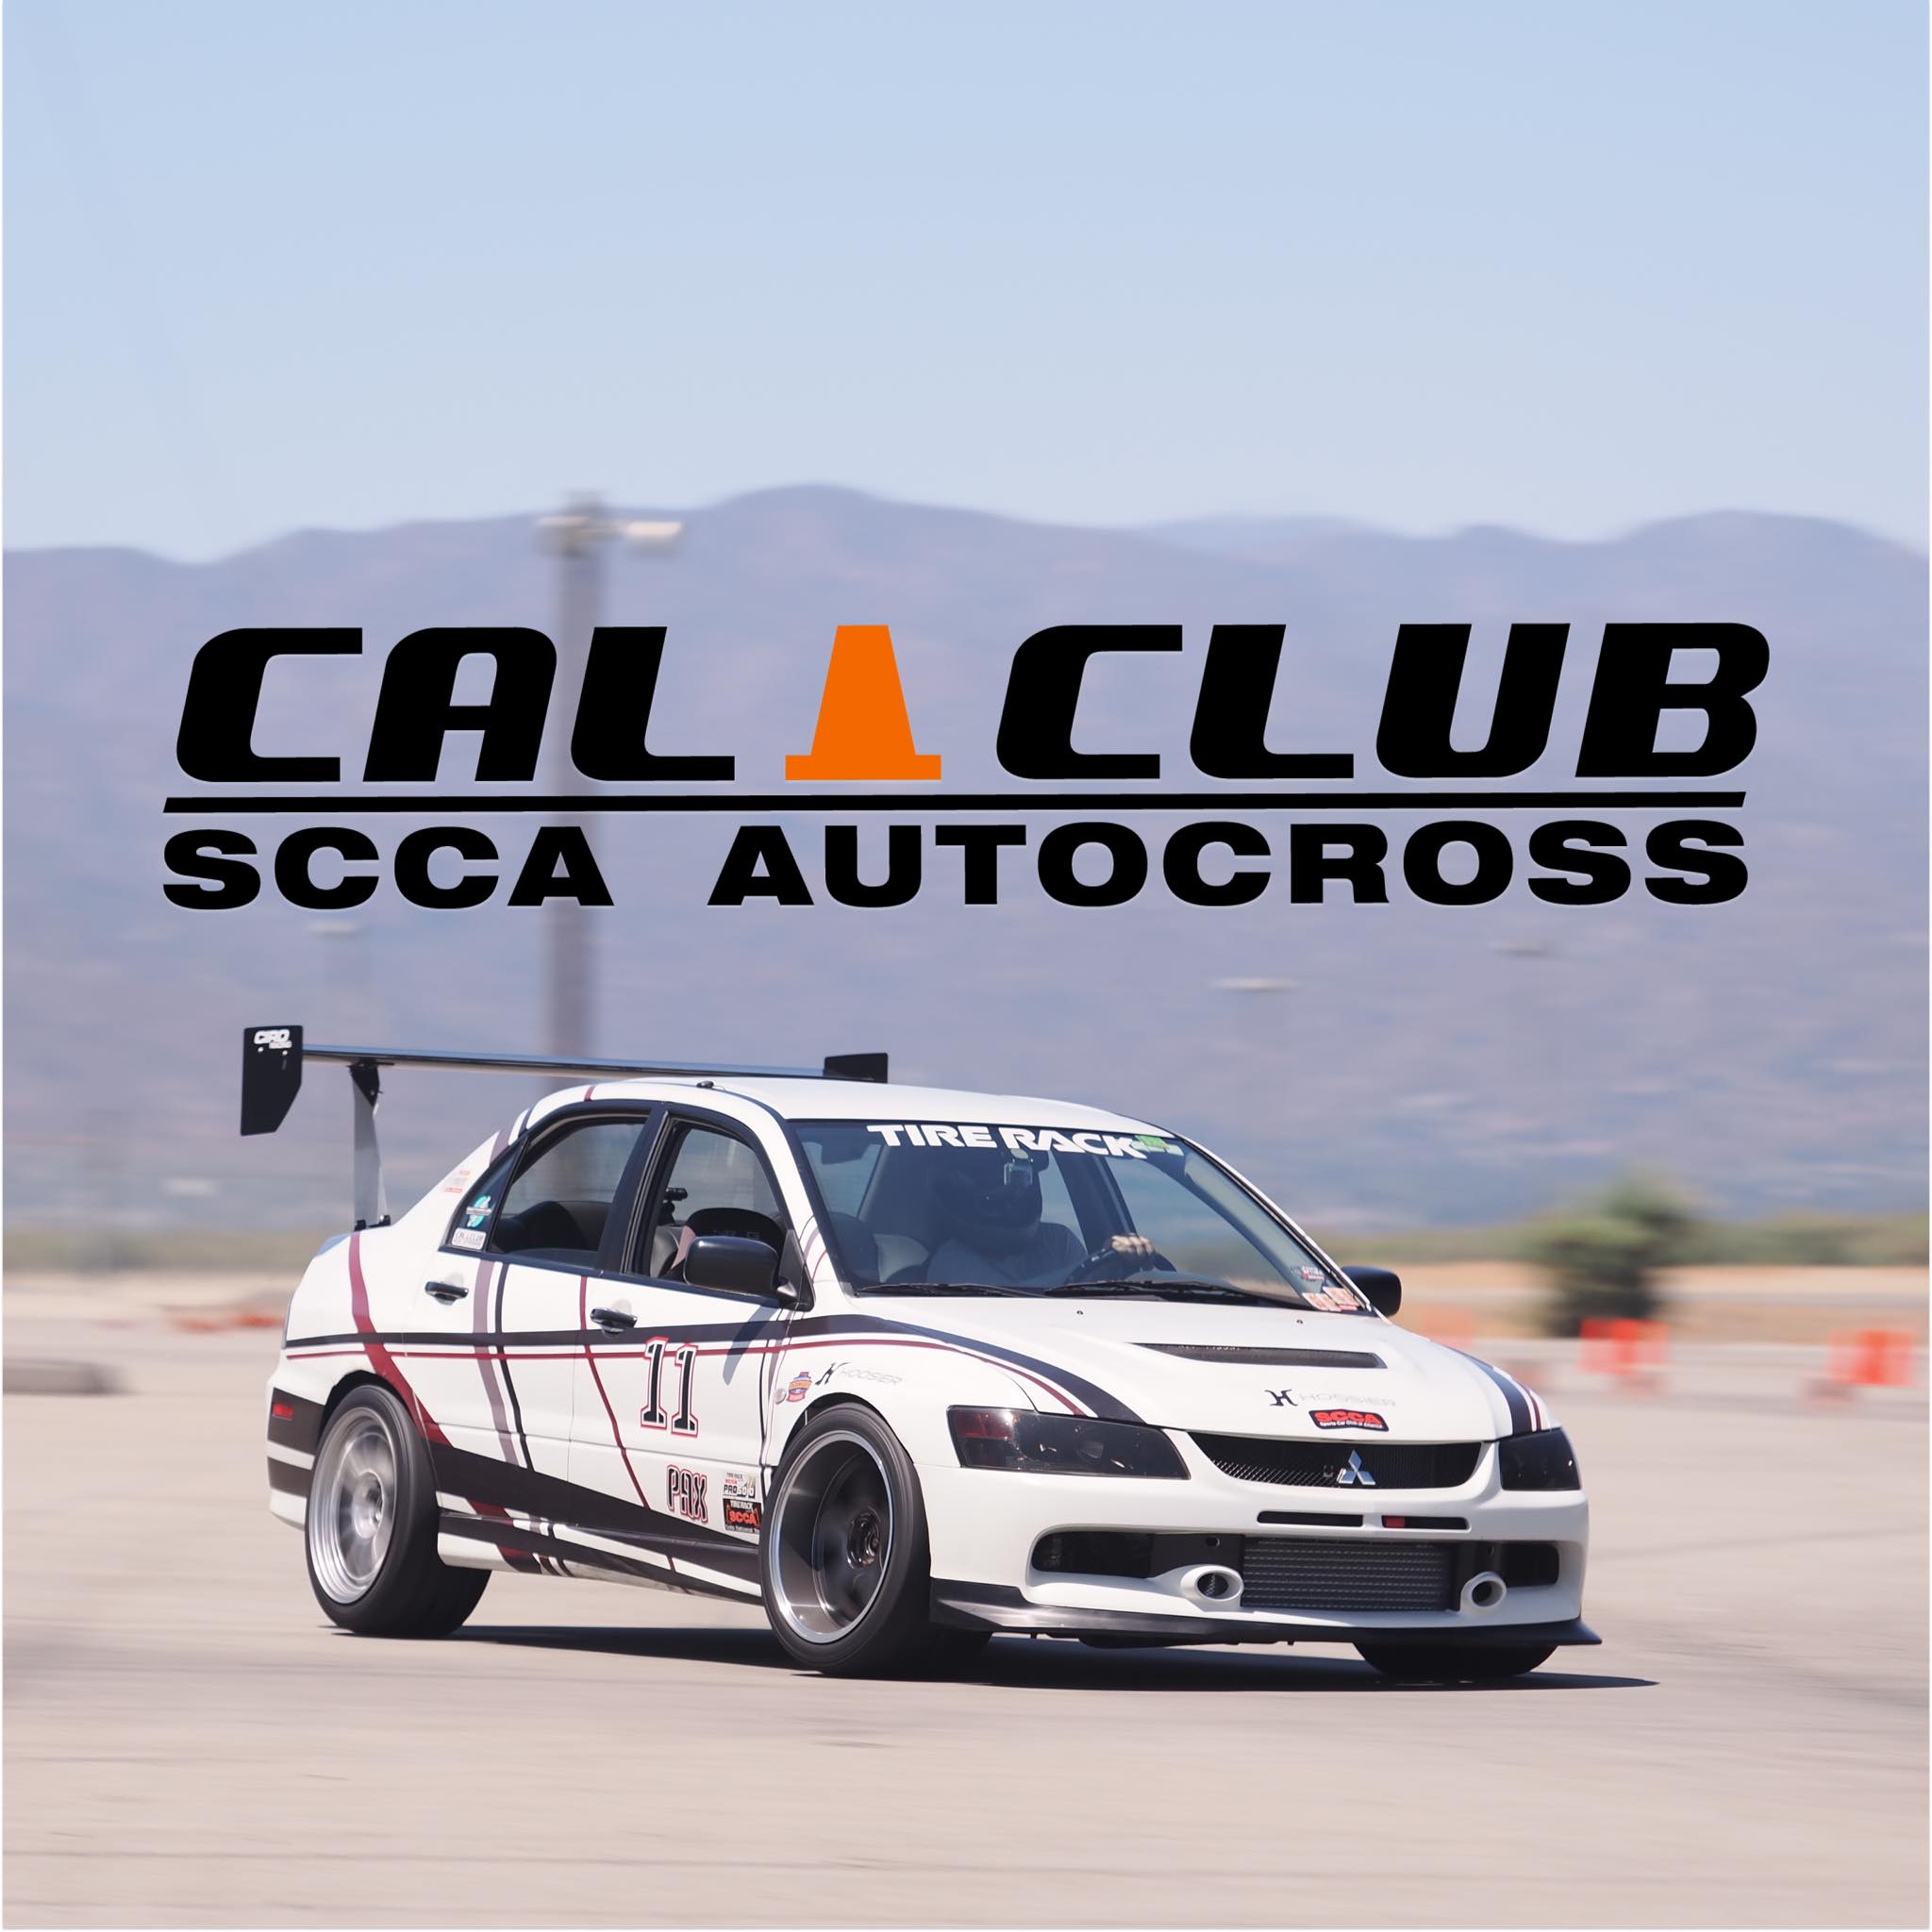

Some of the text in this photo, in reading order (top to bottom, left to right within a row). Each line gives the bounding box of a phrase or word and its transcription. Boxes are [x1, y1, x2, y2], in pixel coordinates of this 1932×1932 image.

[867, 1124, 1147, 1159] TIRE RACK
[641, 1336, 699, 1439] 11
[1314, 1410, 1382, 1423] SCCA
[667, 1464, 708, 1524] PAX
[729, 1510, 756, 1524] SCCA
